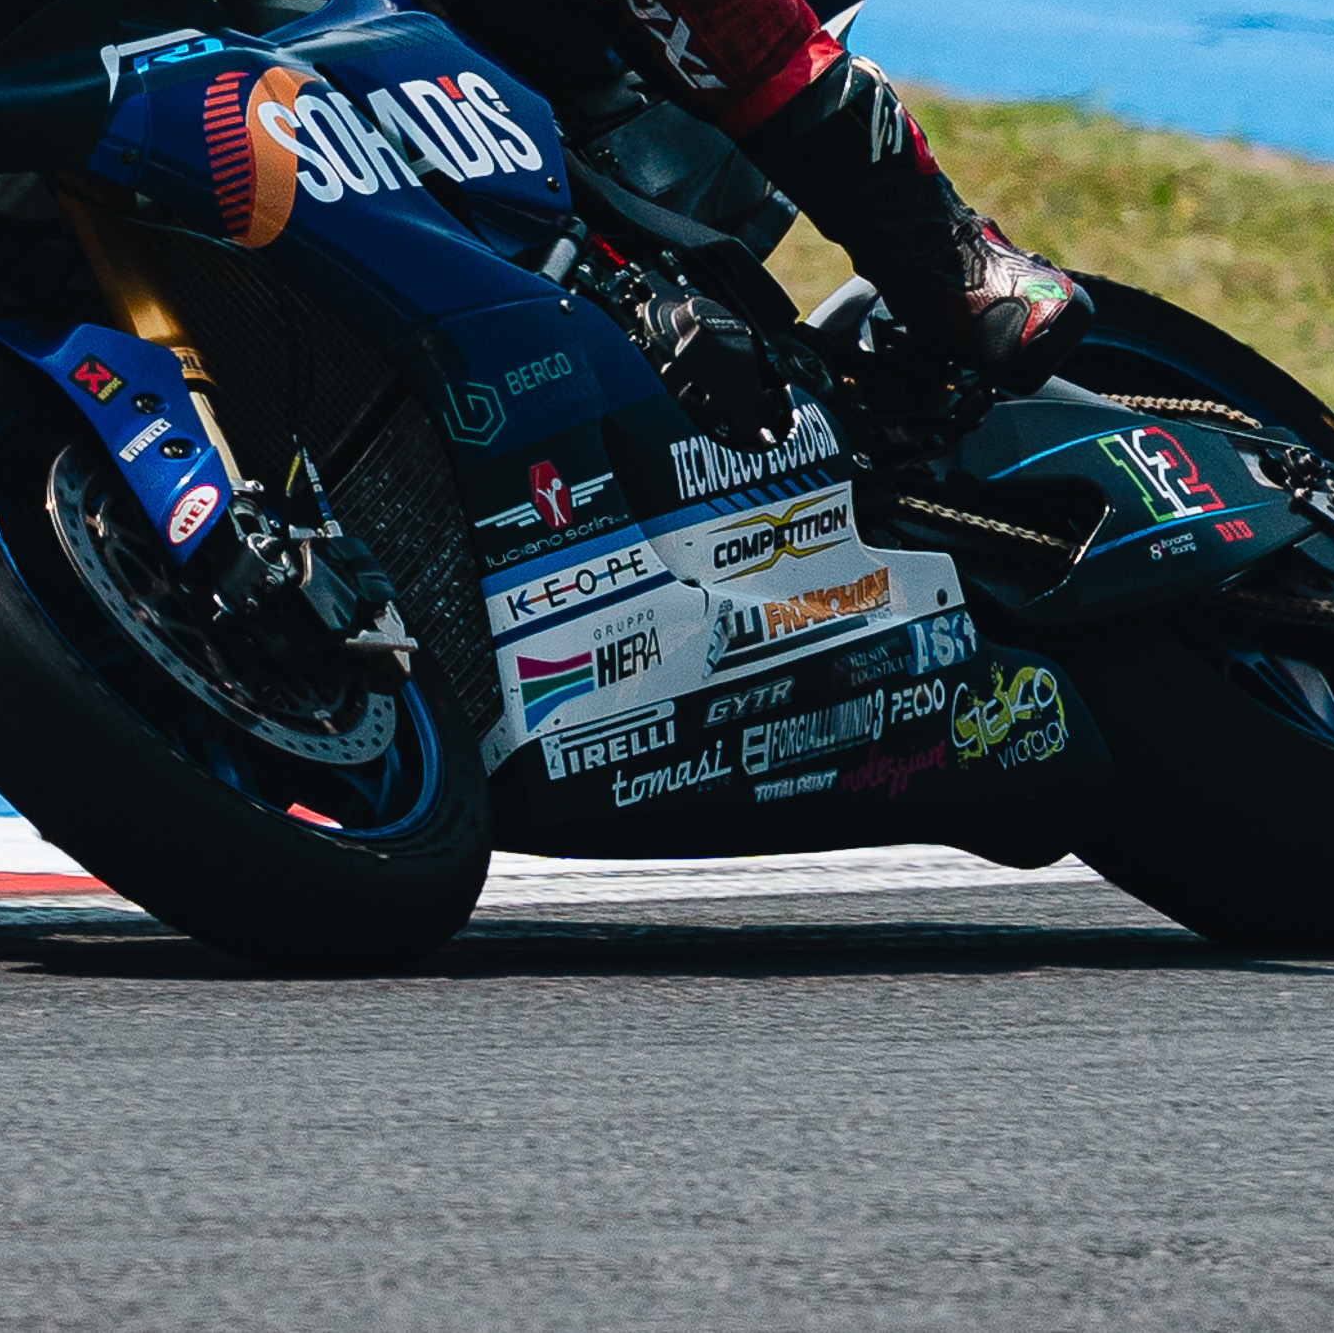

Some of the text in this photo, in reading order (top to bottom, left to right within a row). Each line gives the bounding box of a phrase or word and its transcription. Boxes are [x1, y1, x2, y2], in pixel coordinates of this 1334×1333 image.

[506, 351, 573, 397] BERGO
[118, 417, 172, 463] PIRELLI
[1097, 426, 1225, 523] 12
[178, 497, 212, 535] HEL
[713, 504, 849, 569] COMPETITION
[484, 532, 563, 569] luciano
[506, 547, 648, 621] KEOPE
[592, 608, 656, 641] GRUPPO
[596, 627, 662, 688] HERA
[703, 676, 796, 727] GYTR
[951, 667, 1058, 754] GEKO
[541, 700, 676, 781] PIRELLI
[997, 710, 1069, 769] viaggi
[612, 740, 732, 808] tomasi
